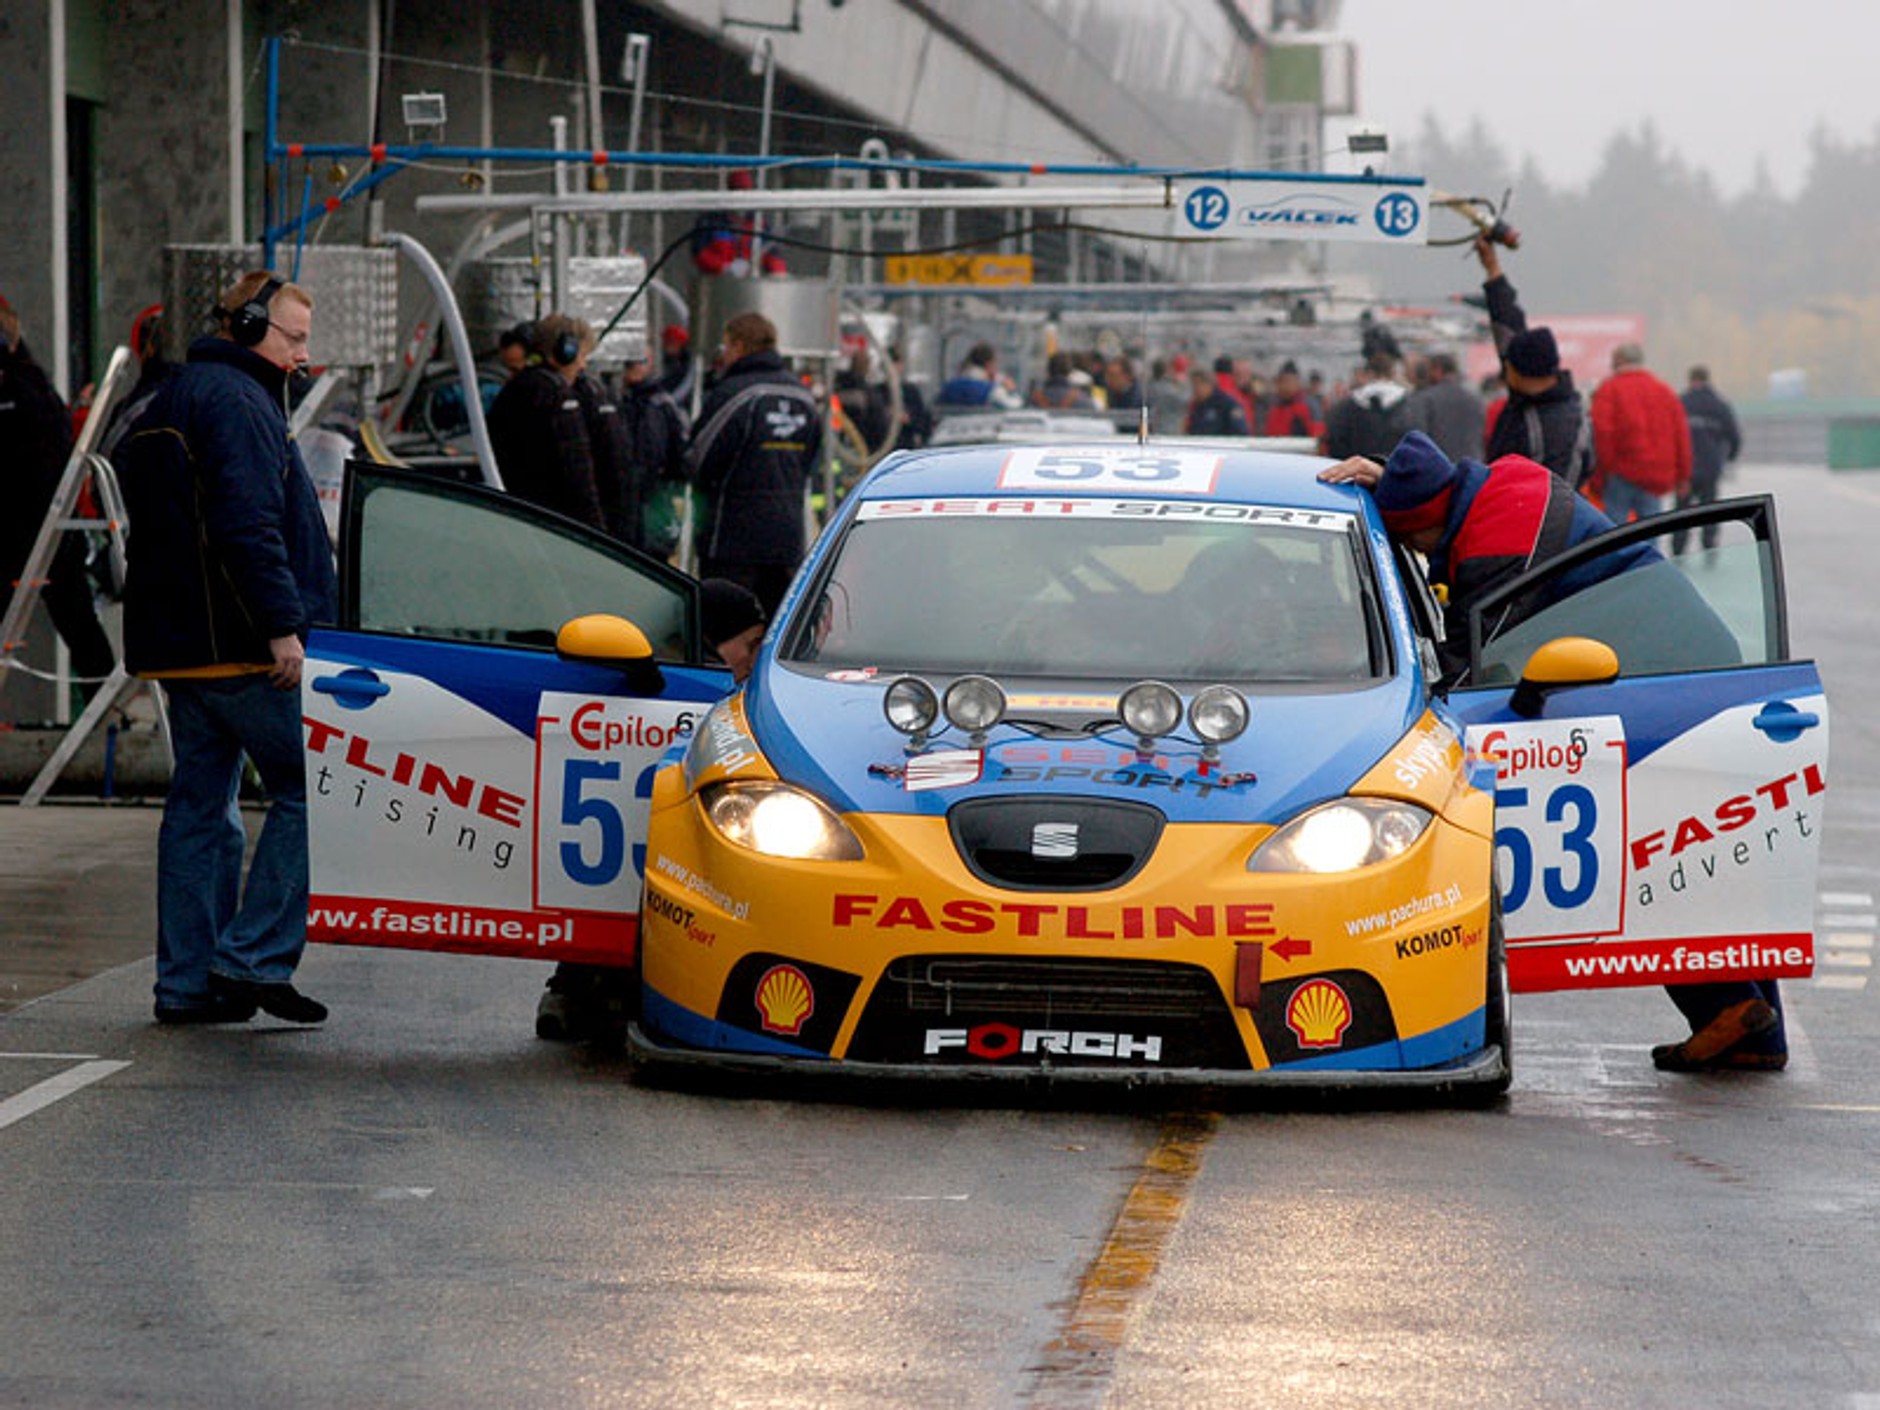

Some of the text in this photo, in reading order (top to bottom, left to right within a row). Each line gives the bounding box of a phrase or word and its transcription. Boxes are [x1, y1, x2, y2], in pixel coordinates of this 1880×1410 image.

[1188, 193, 1224, 223] 12
[1379, 200, 1413, 229] 13
[1034, 456, 1181, 481] 53
[877, 501, 1336, 524] SEAT SPORT
[570, 702, 679, 751] Epilo
[301, 714, 527, 828] TLINE
[1481, 730, 1582, 779] Epilog
[997, 766, 1228, 798] SPORT
[317, 766, 514, 869] tising
[560, 759, 657, 886] 5
[1495, 783, 1598, 914] 53
[1638, 811, 1812, 906] advert
[833, 894, 1277, 939] FASTLINE
[1345, 883, 1463, 936] www.pachura.pl
[1396, 925, 1463, 959] KOMOT
[1565, 944, 1814, 976] www.fastline.
